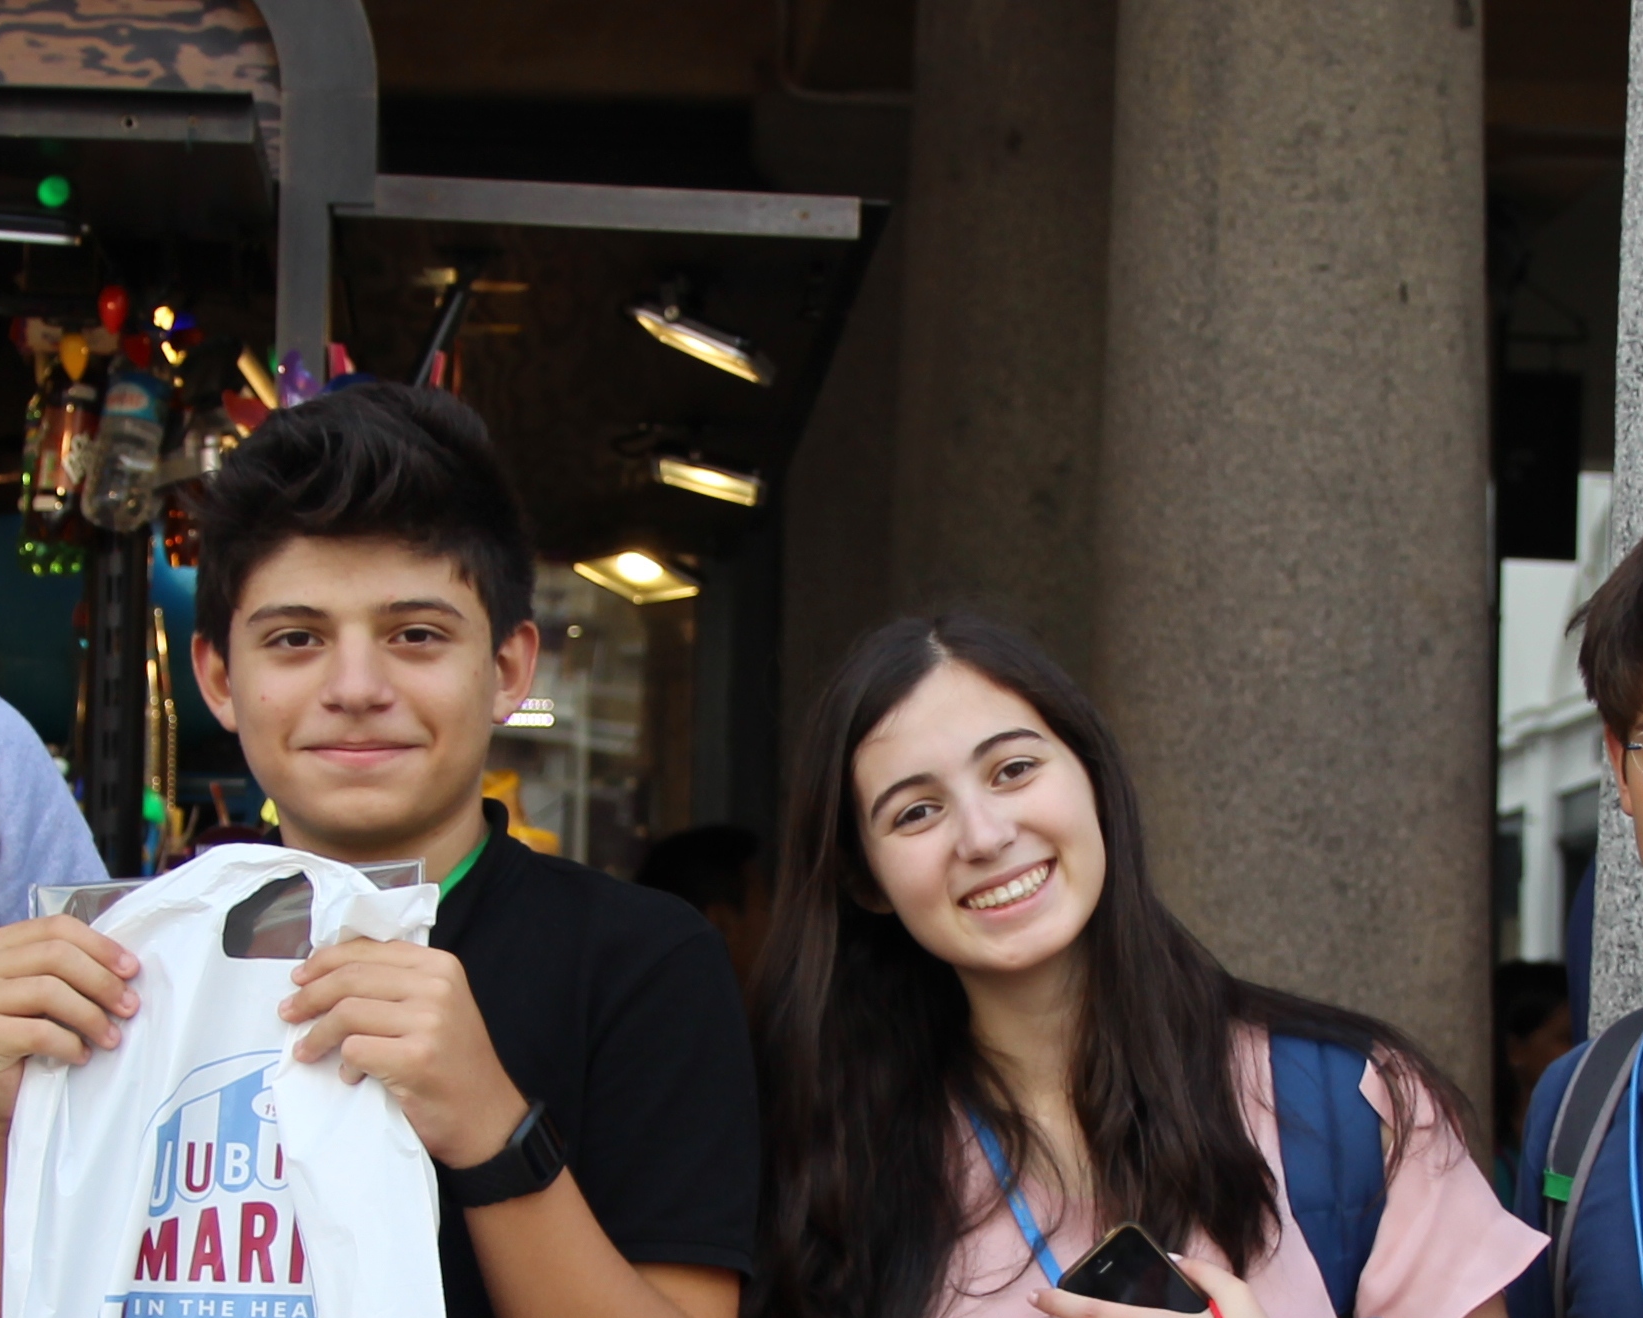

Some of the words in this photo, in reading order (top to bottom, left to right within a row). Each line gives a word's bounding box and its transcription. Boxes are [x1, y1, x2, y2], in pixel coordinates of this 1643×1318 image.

[150, 1140, 284, 1208] JUBI
[133, 1298, 165, 1316] IN
[179, 1299, 235, 1317] THE
[250, 1300, 317, 1318] HEA
